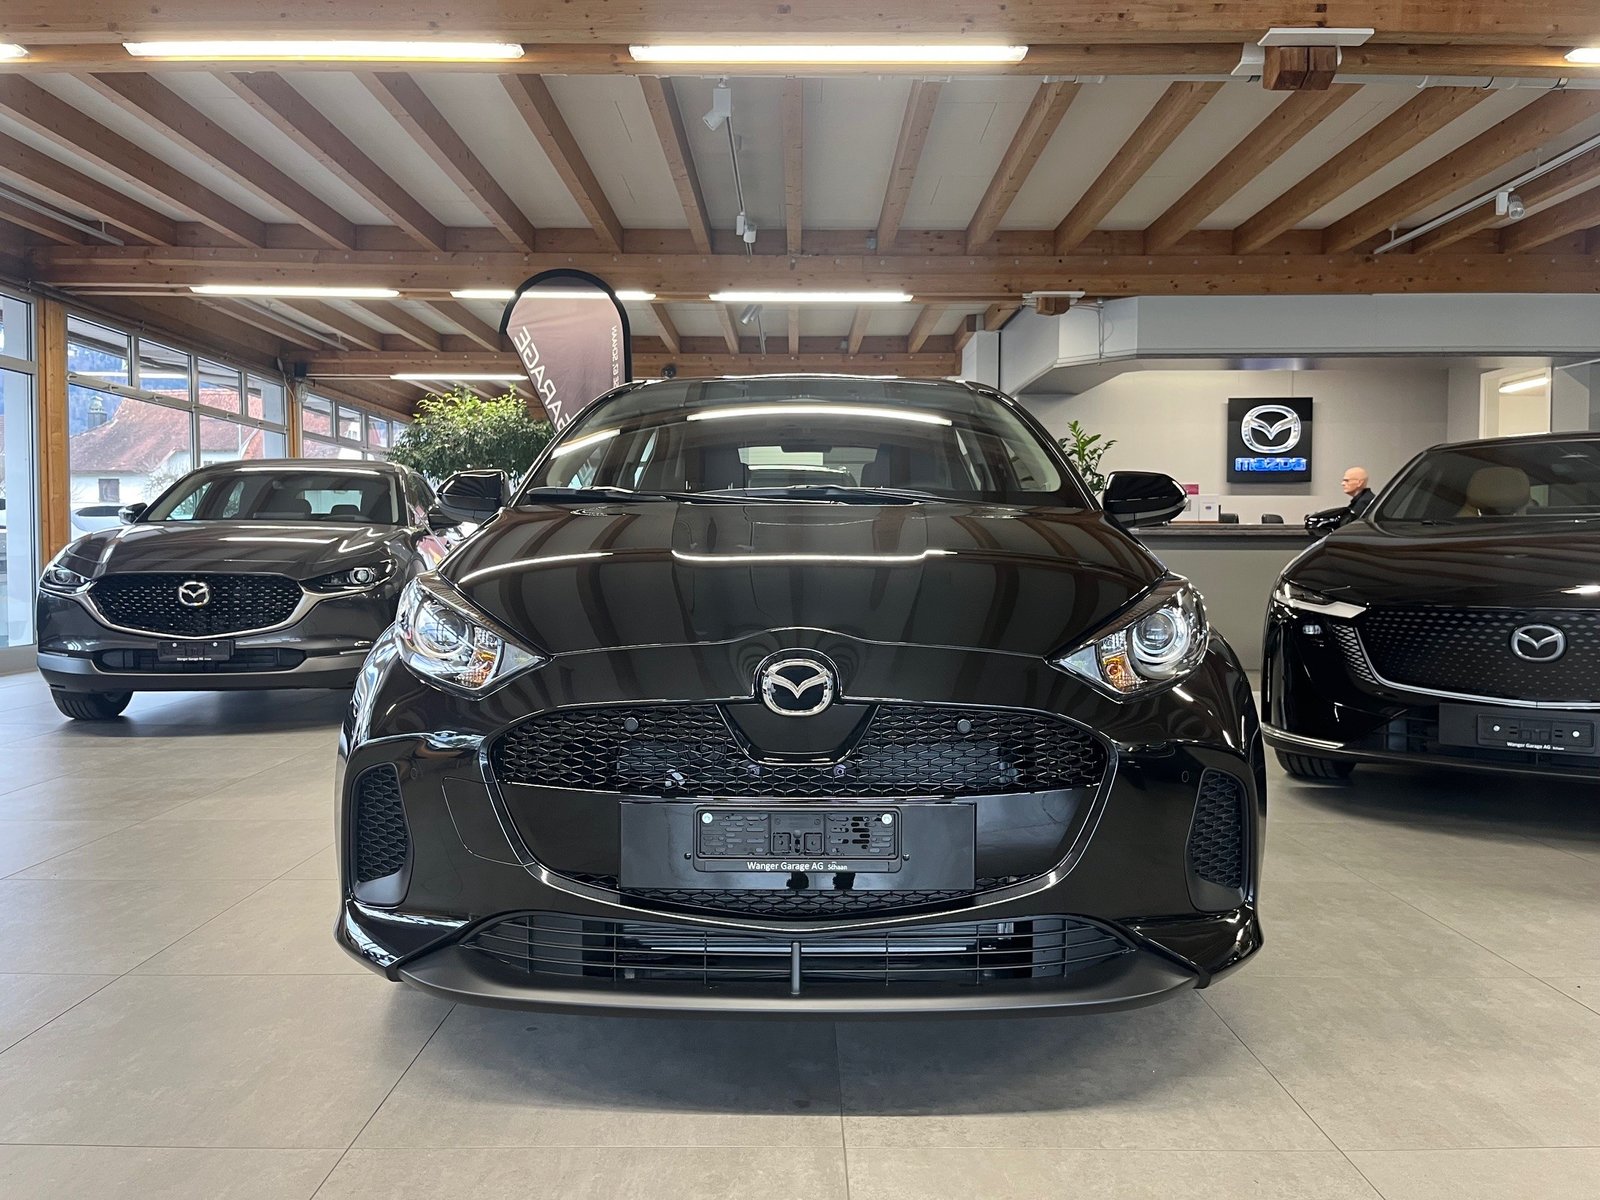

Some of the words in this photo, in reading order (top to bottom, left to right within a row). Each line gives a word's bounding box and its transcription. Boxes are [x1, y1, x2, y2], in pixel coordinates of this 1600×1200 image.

[747, 861, 779, 872] Wanger
[780, 862, 810, 872] Garage
[811, 862, 824, 870] AG
